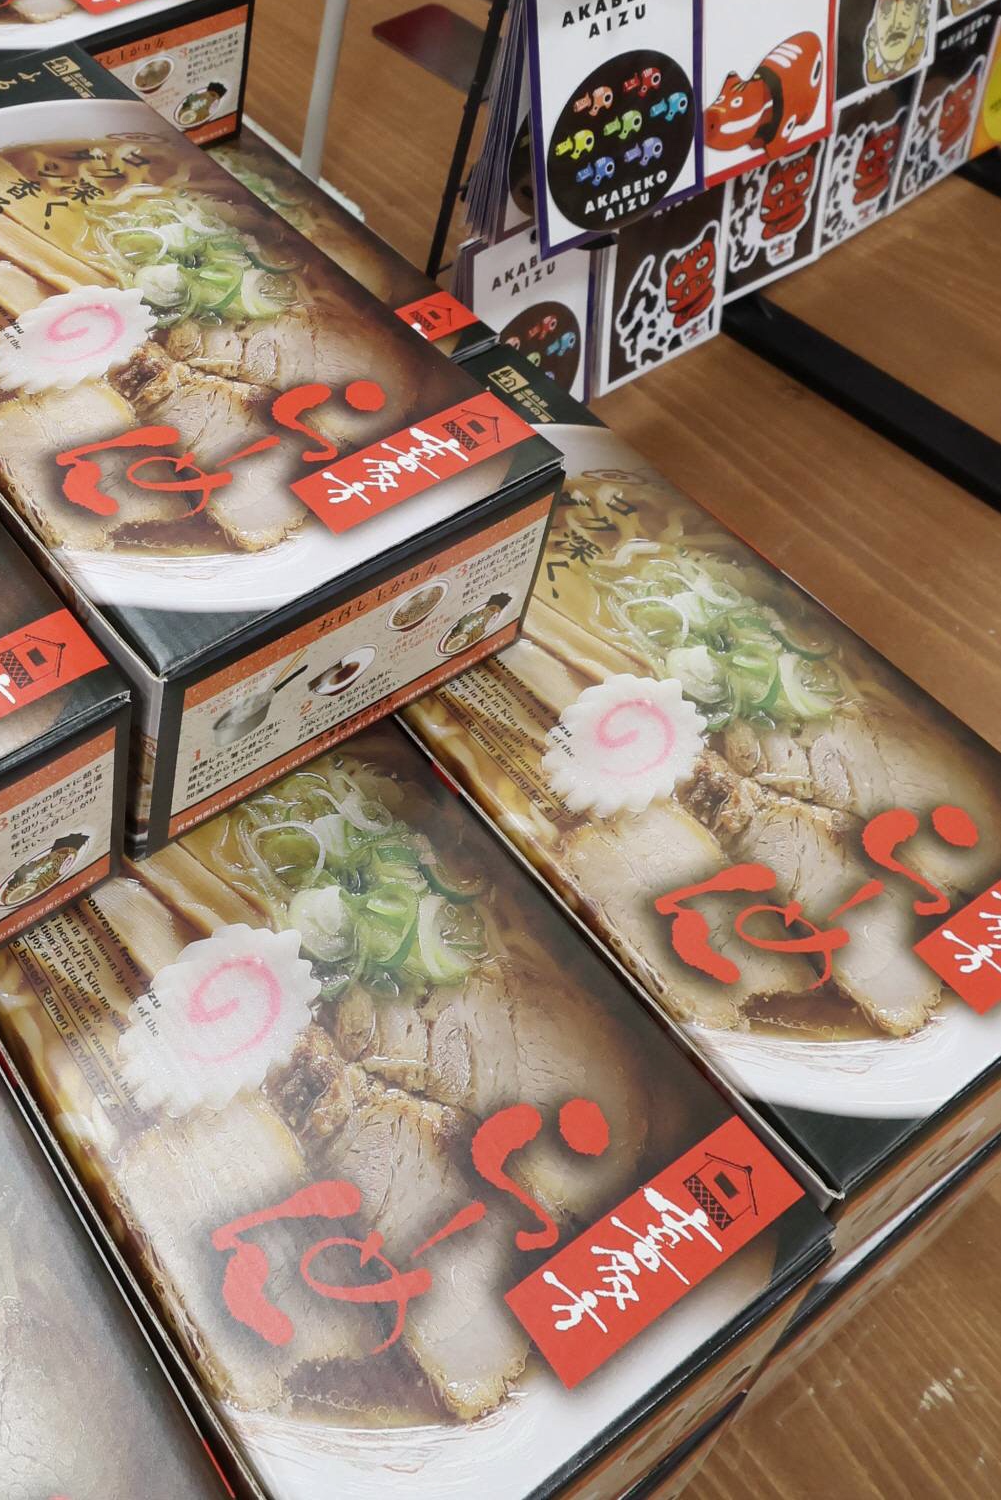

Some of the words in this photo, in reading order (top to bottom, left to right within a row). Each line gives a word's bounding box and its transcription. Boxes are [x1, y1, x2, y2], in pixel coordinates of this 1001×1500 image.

[588, 4, 647, 39] AIZU
[583, 169, 669, 214] AKABEKO
[604, 192, 650, 221] AIZU
[510, 260, 557, 297] AIZU
[54, 380, 381, 515] らーめん
[321, 428, 467, 503] 喜多方
[463, 719, 498, 752] Ramen
[493, 752, 531, 790] serving
[651, 805, 976, 982] らーめん
[53, 922, 81, 959] located
[75, 936, 105, 973] Japan.
[39, 985, 72, 1030] Ramen
[63, 1030, 100, 1080] serving
[209, 1099, 606, 1345] らーめん
[541, 1190, 721, 1330] 喜多方
